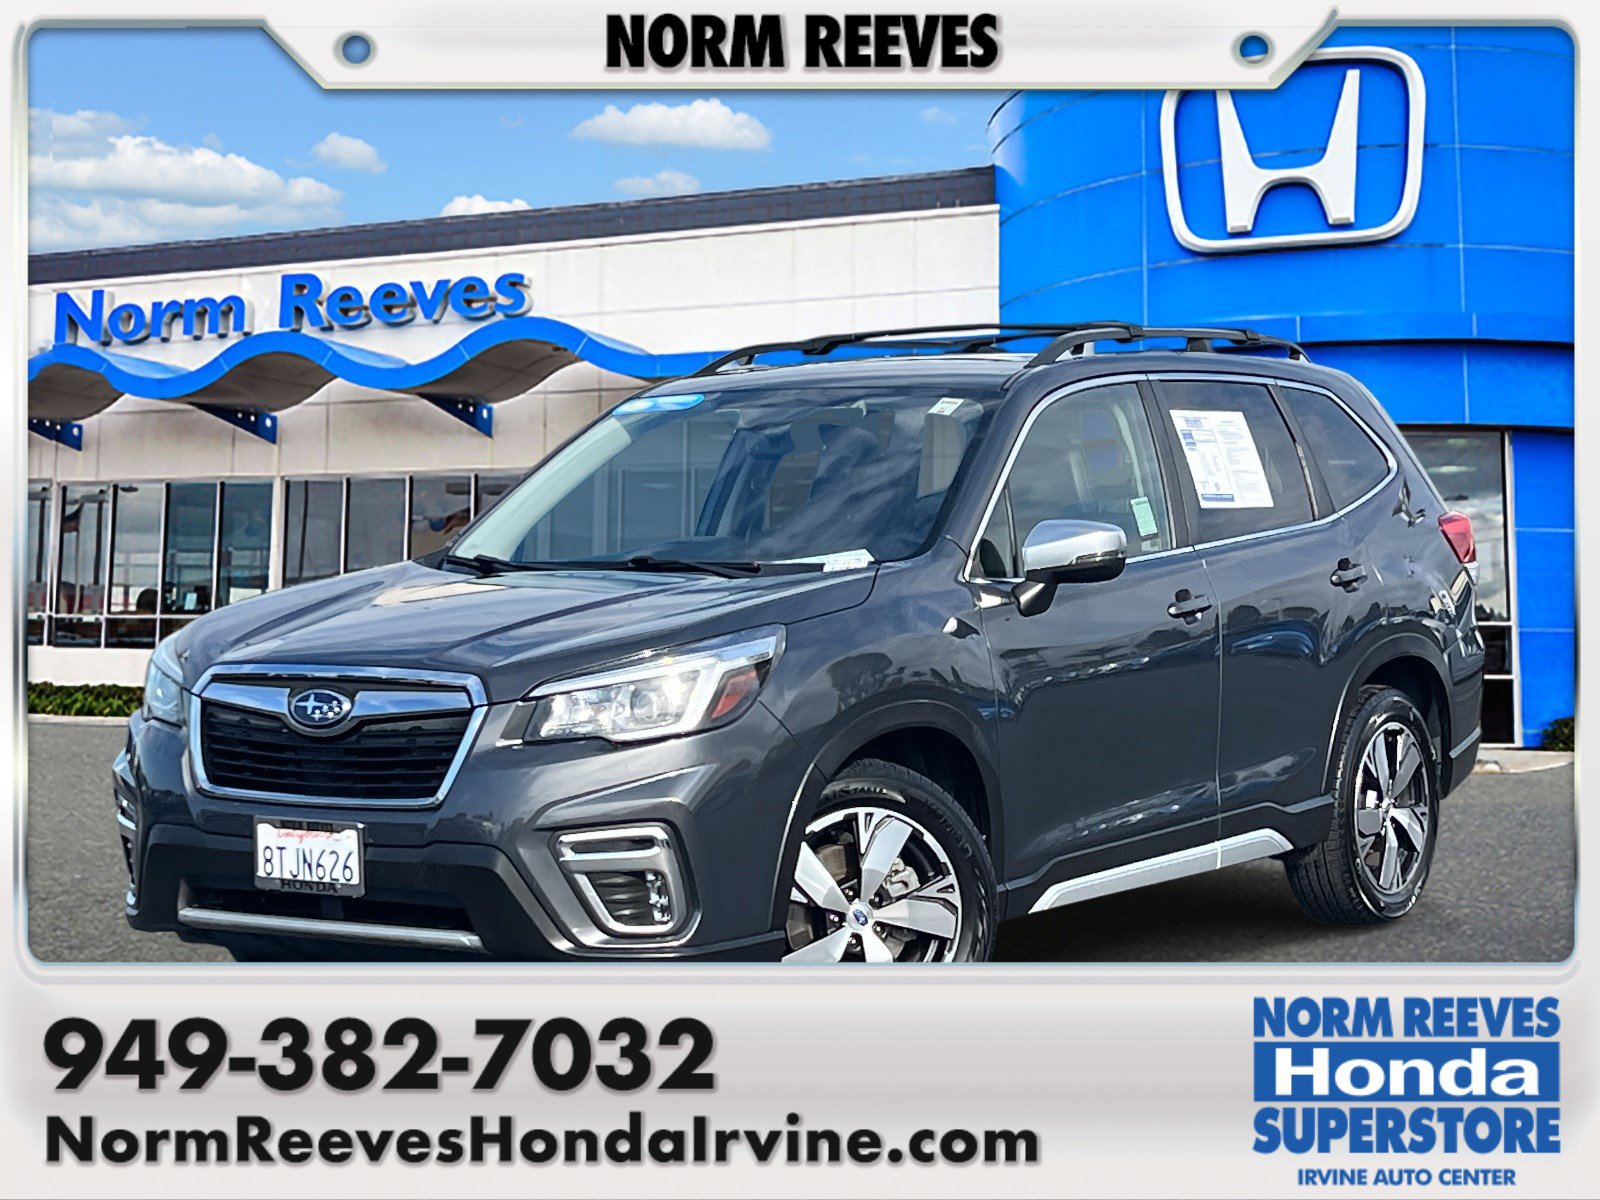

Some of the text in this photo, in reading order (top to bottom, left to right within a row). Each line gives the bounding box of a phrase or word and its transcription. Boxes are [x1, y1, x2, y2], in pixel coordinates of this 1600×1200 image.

[55, 272, 528, 345] Norm Reeves
[263, 845, 354, 882] 8TJN626
[279, 879, 339, 894] HONDA
